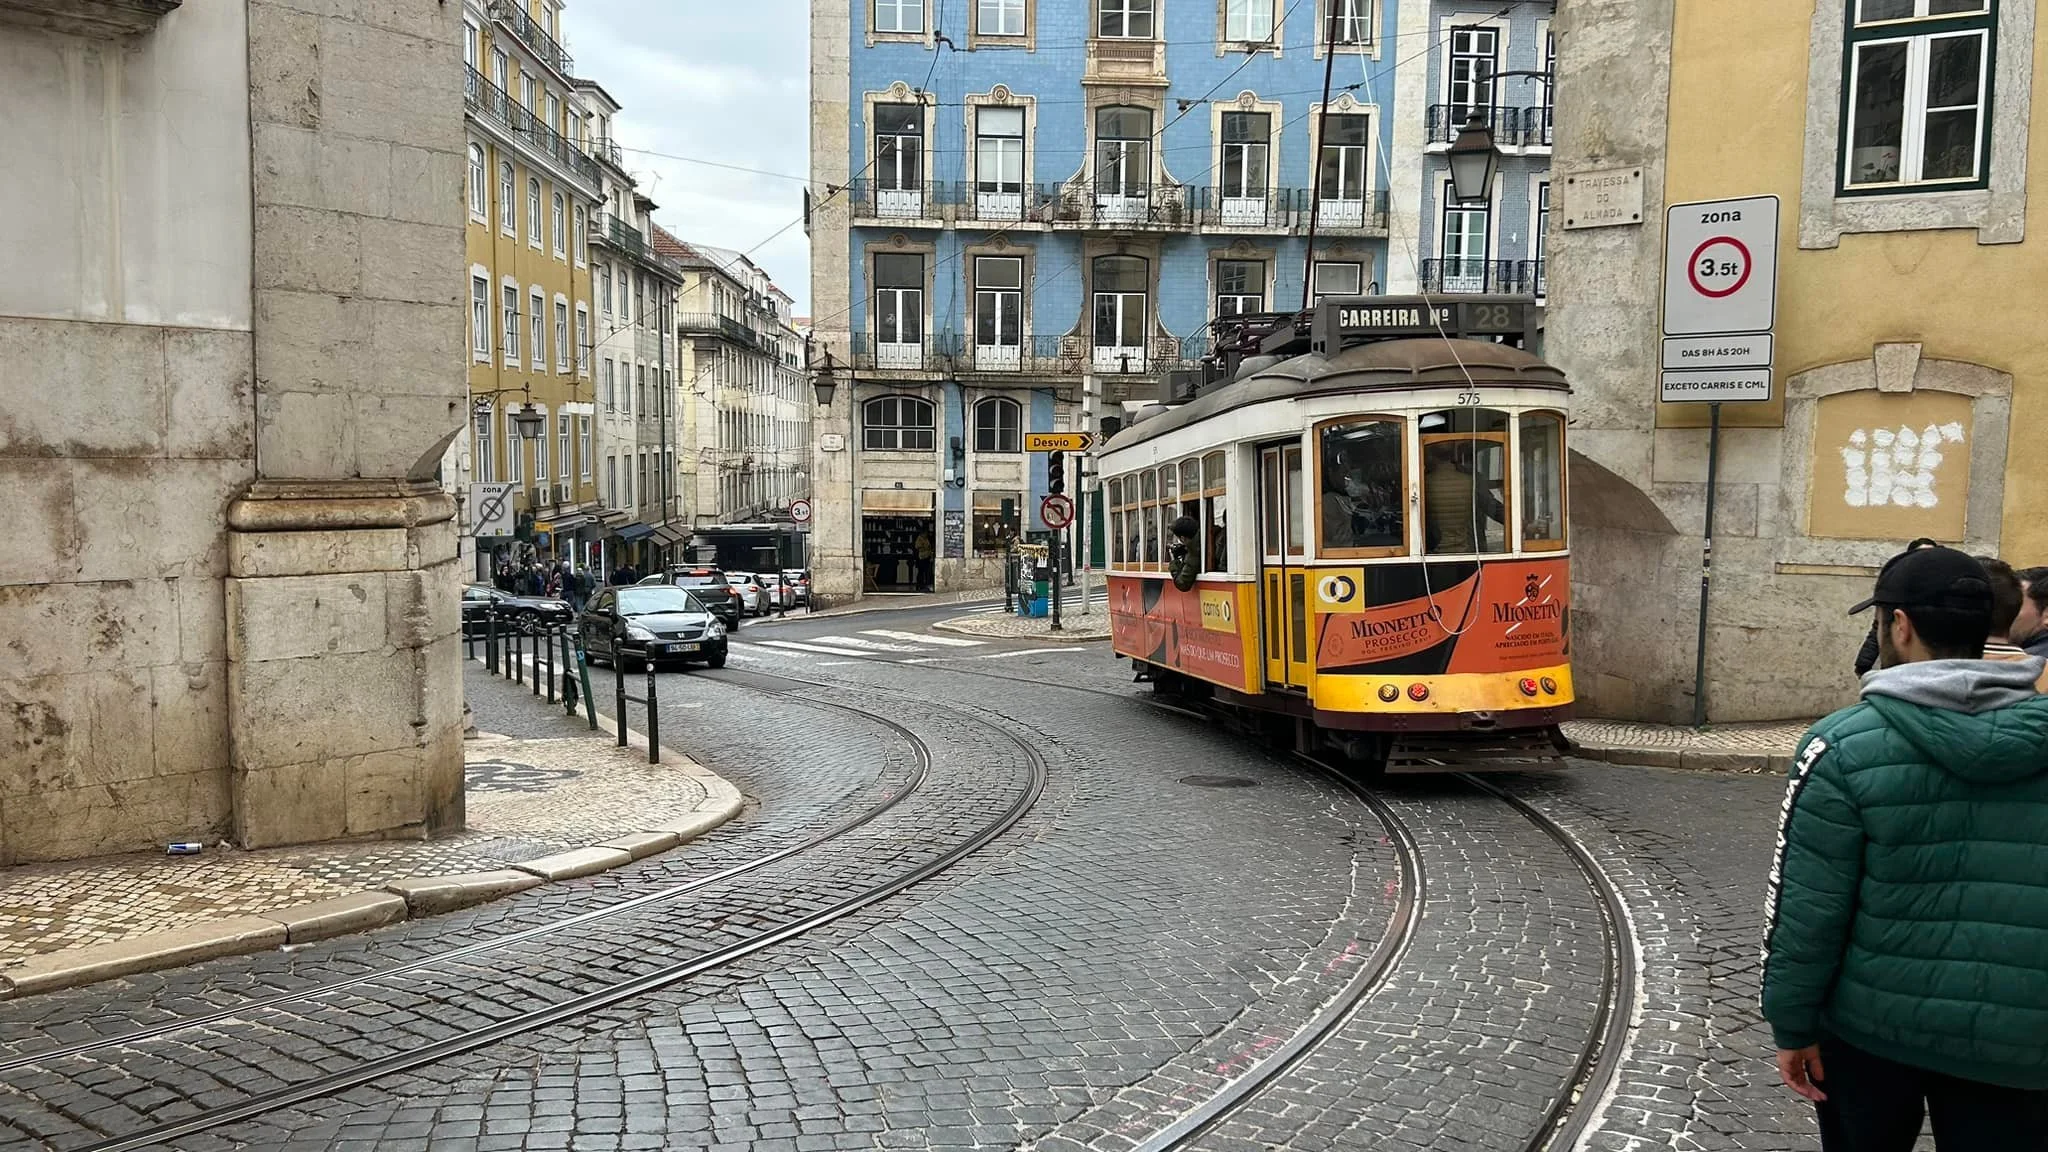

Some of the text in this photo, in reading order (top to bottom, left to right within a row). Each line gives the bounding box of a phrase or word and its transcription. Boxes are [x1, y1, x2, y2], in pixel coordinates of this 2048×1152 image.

[1580, 176, 1629, 189] TRAVESSA
[1596, 193, 1609, 203] DO
[1583, 208, 1623, 220] ALMADA
[1701, 210, 1741, 224] zona
[1700, 258, 1739, 277] 3.5t
[1339, 308, 1449, 327] CARREIRA Nº
[1475, 304, 1510, 328] 28
[1681, 349, 1700, 357] DAS
[1702, 348, 1715, 357] 8H
[1731, 347, 1750, 356] 20H
[1664, 381, 1766, 390] EXCETO CARRIS E CML
[1458, 392, 1481, 405] 575
[1033, 437, 1069, 447] Desvio
[1350, 604, 1442, 639] MIONETTO
[1364, 627, 1428, 649] PROSECCO
[1797, 736, 1828, 777] SET
